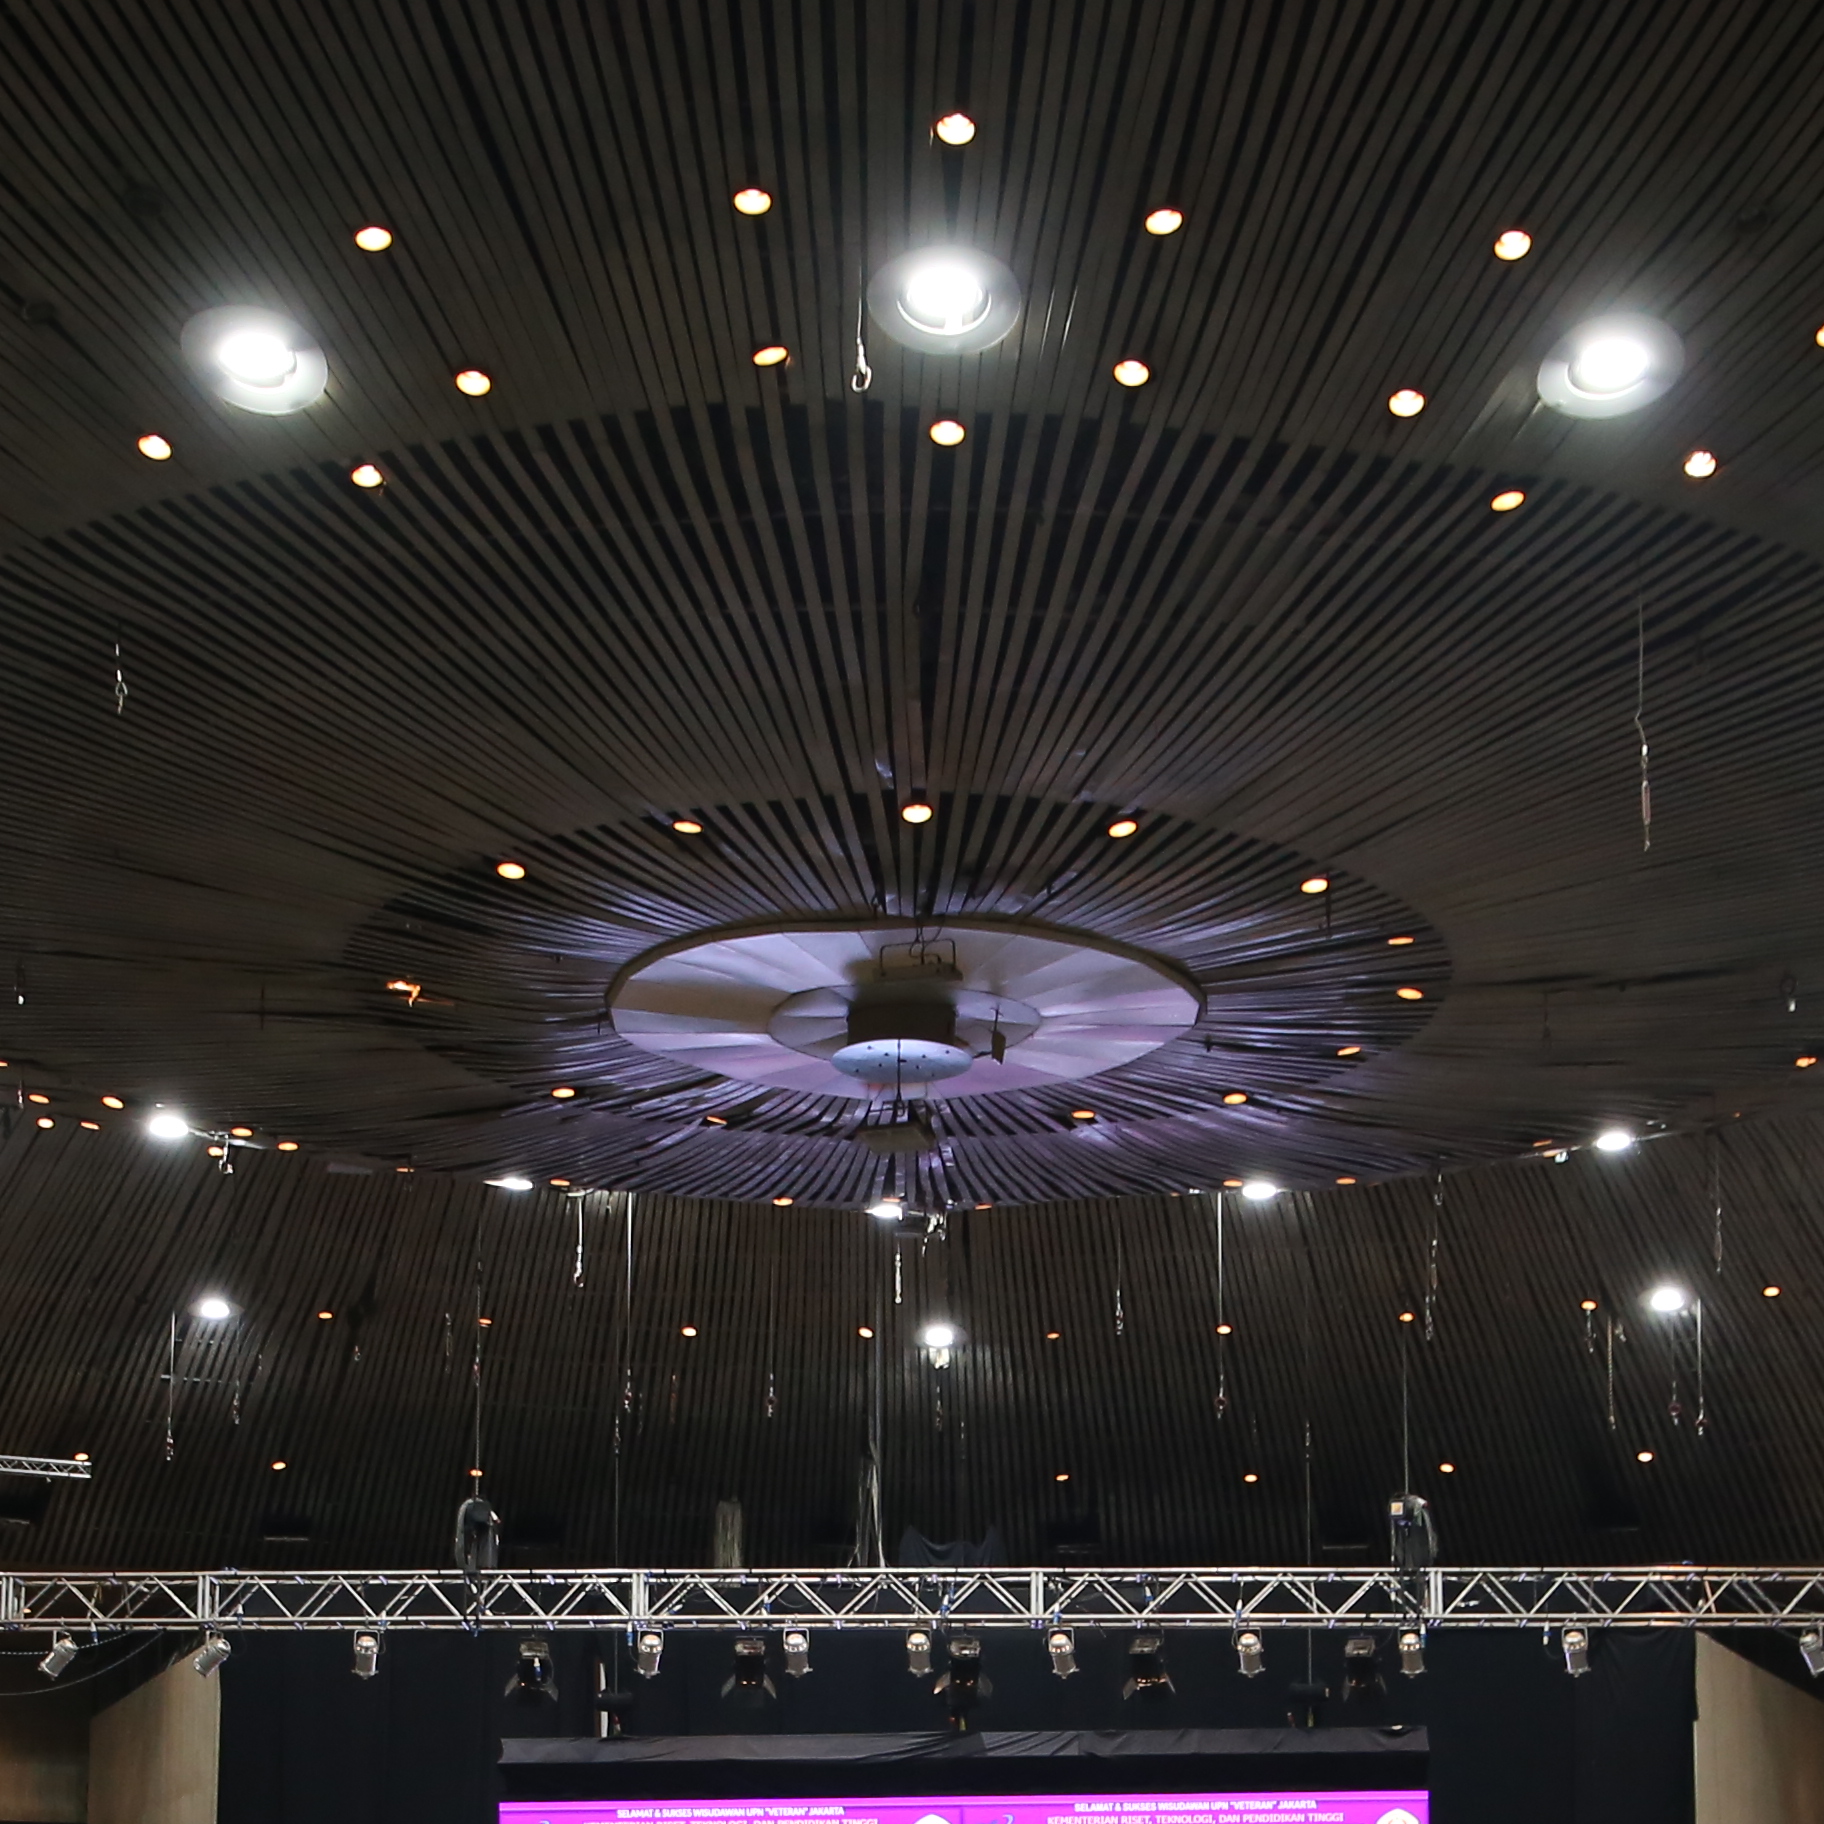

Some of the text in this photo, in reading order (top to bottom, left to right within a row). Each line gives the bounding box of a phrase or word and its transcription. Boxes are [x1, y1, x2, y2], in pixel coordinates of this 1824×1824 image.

[616, 1806, 844, 1818] SELAMAT & SUKSES WISUDAWAN UPN "VETERAN" JAKARTA
[1074, 1800, 1317, 1812] SELAMAT & SUKSES WISUDAWAN UPN "VETERAN" JAKARTA
[1155, 1814, 1216, 1824] TEKNOLOGI,
[1219, 1814, 1240, 1823] DAN
[1243, 1814, 1304, 1823] PENDIDIKAN
[1307, 1812, 1344, 1822] TINGGI
